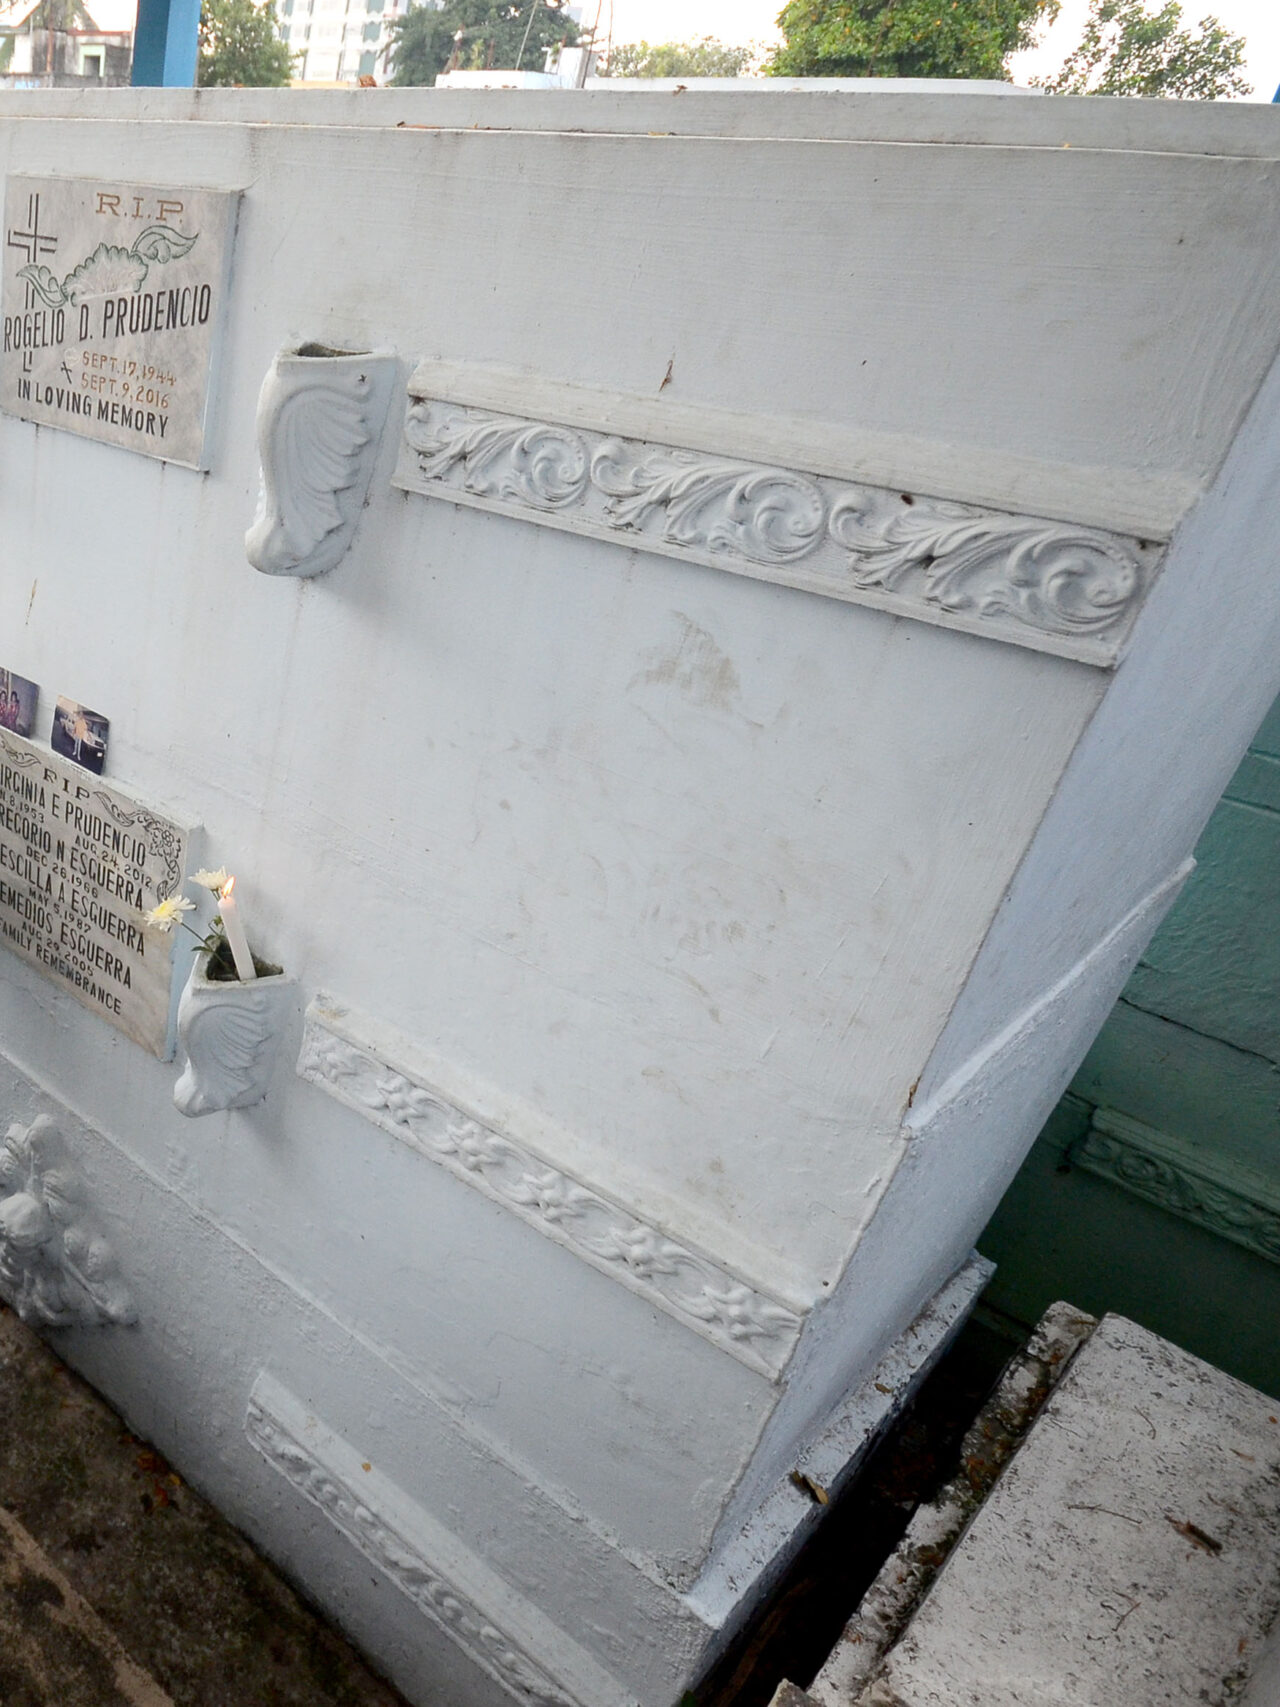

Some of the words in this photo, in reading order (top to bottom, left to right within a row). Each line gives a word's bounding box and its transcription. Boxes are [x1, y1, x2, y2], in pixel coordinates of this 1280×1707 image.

[4, 308, 65, 352] ROGELIO
[79, 304, 93, 342] D.
[102, 284, 211, 338] PRUDENCIO
[18, 378, 31, 400] IN
[35, 382, 92, 416] LOVING
[97, 398, 169, 438] MEMORY
[26, 845, 48, 867] DEC
[51, 793, 60, 818] E
[65, 801, 146, 867] PRUDENCIO
[29, 887, 49, 907] MAY
[56, 840, 64, 863] N
[70, 847, 143, 912] ESGUERRA
[22, 921, 42, 941] AUG
[58, 882, 65, 903] A
[71, 888, 145, 957] ESGUERRA
[36, 943, 122, 1015] REMEMBRANCE
[60, 921, 132, 990] ESGUERRA
